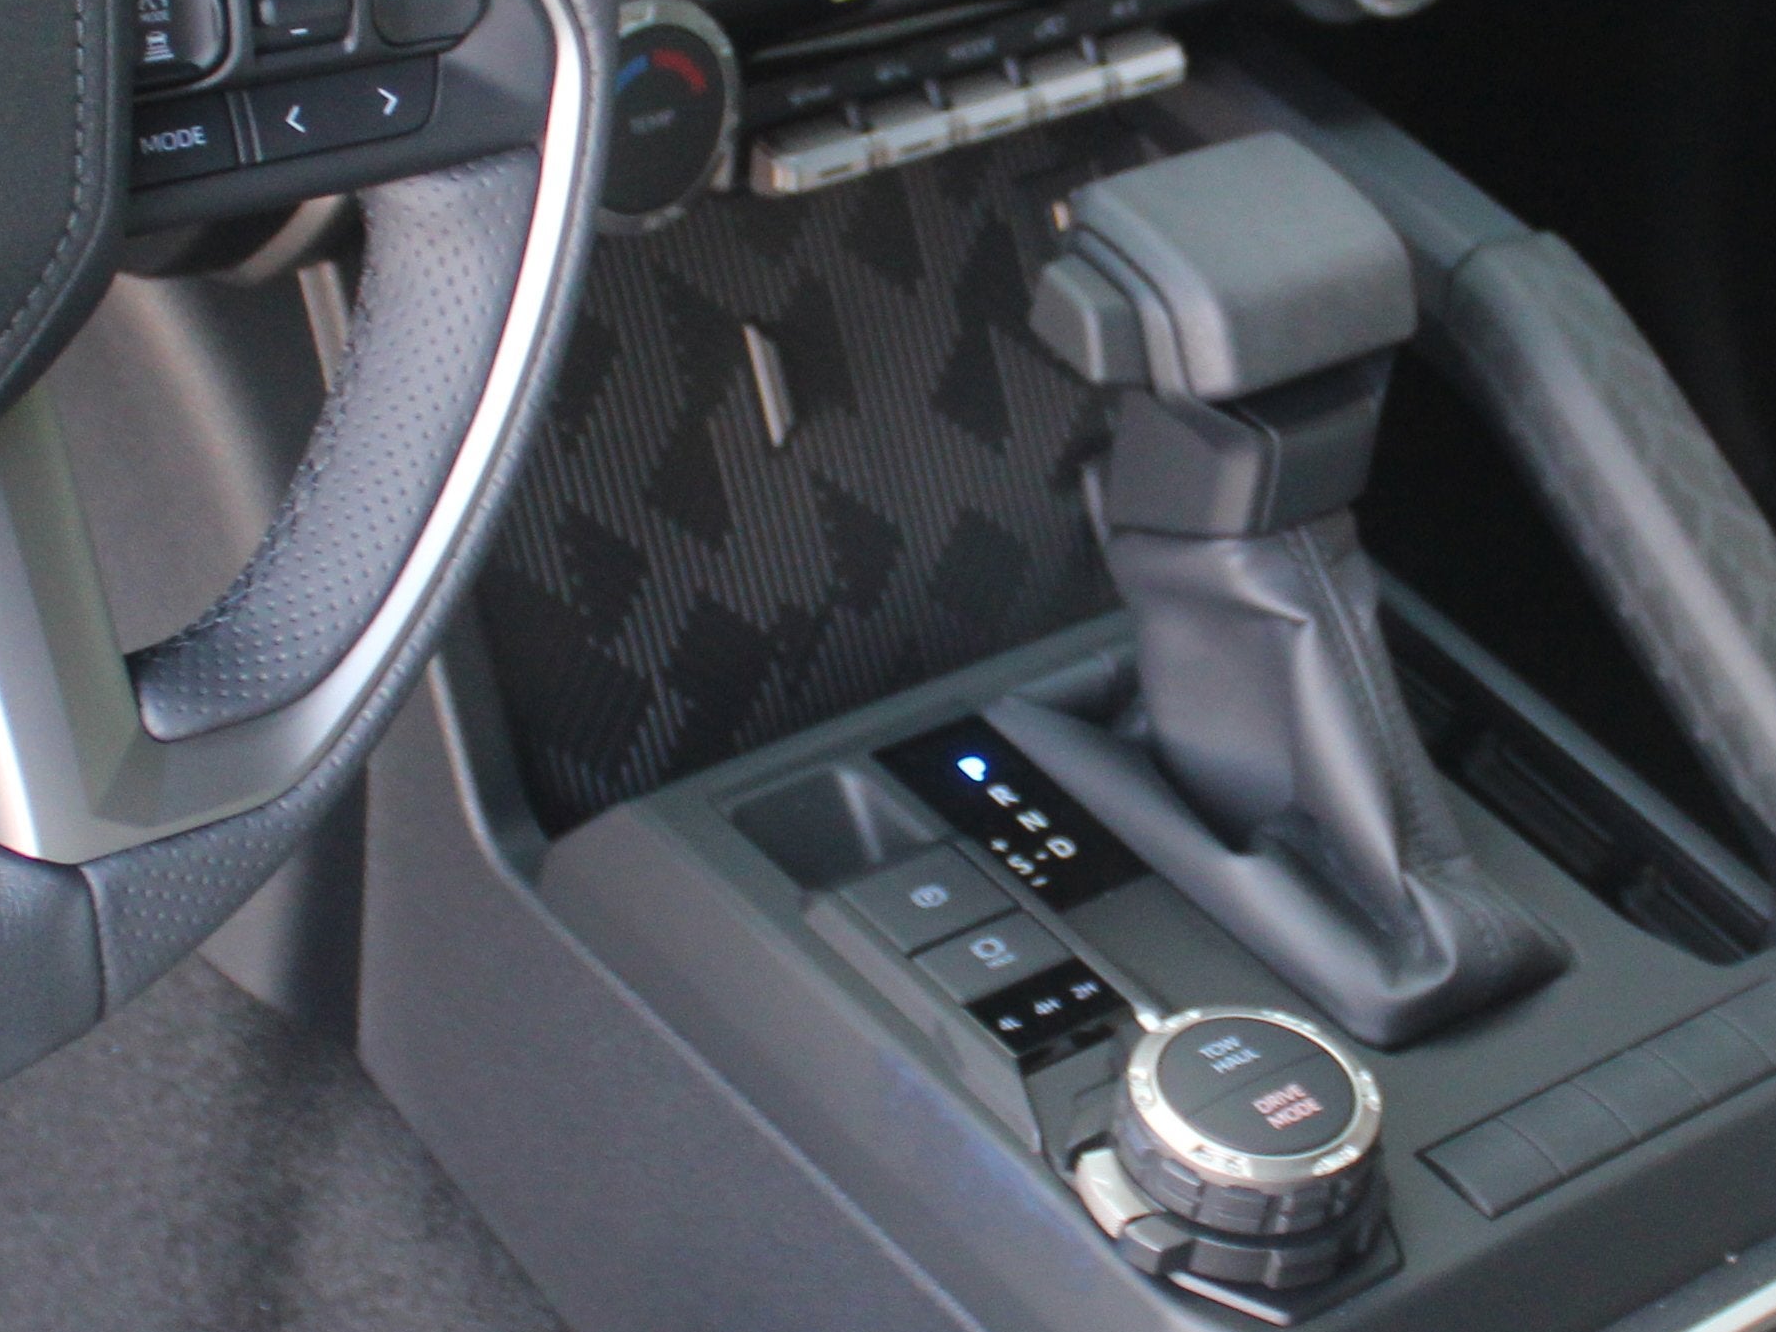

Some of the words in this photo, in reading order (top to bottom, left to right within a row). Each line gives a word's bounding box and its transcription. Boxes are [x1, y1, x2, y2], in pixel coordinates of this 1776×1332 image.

[139, 126, 207, 154] MODE
[986, 783, 1021, 808] R
[1016, 808, 1050, 833] N
[1045, 835, 1077, 859] D
[1197, 1035, 1242, 1060] TOW
[1212, 1048, 1261, 1074] HAUL
[1251, 1083, 1307, 1116] DRIVE
[1265, 1097, 1323, 1131] MODE
